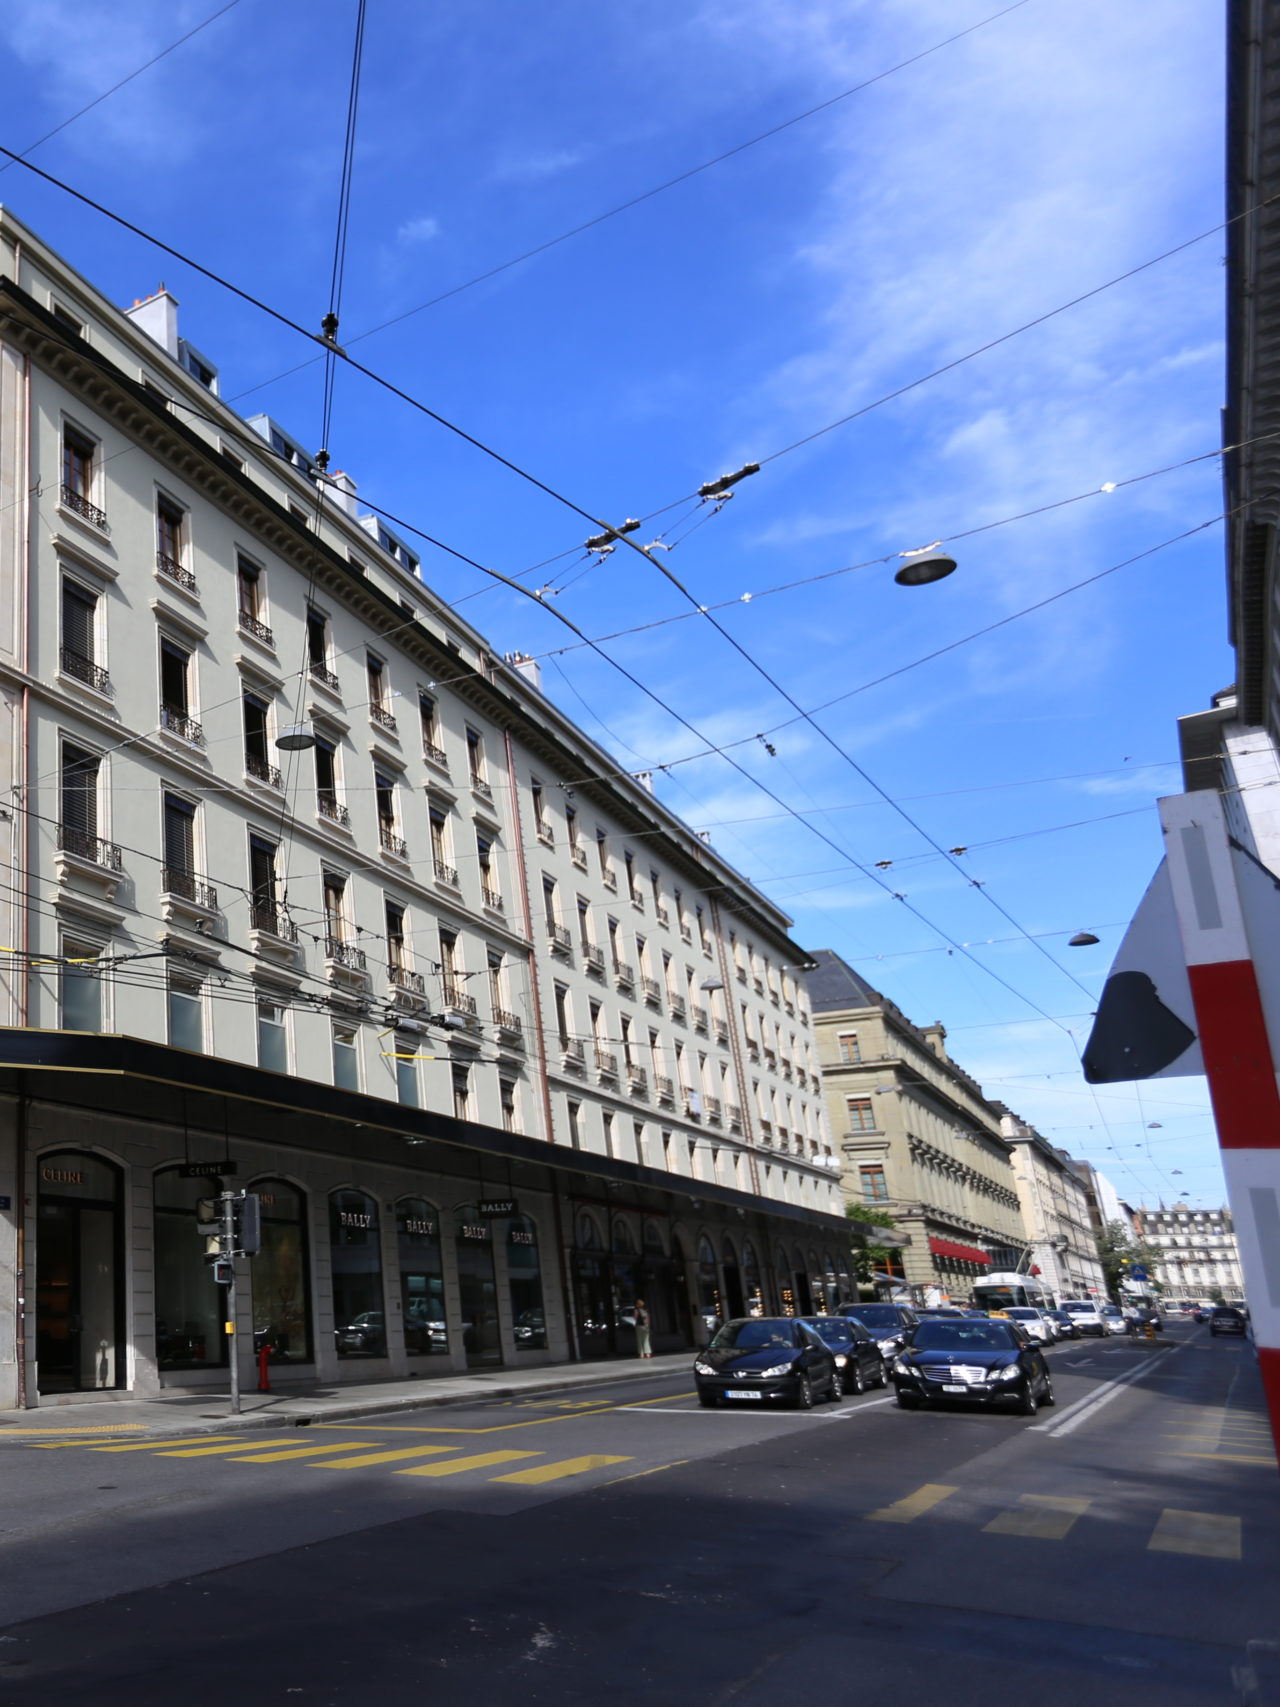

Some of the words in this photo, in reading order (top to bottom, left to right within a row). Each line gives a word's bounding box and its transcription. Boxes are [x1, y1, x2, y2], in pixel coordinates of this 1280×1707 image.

[42, 1167, 84, 1184] CELINE
[189, 1165, 223, 1176] CELINE
[481, 1202, 513, 1212] BALLY
[340, 1212, 371, 1228] BALLY
[406, 1219, 433, 1234] BALLY
[463, 1225, 487, 1239] BALLY
